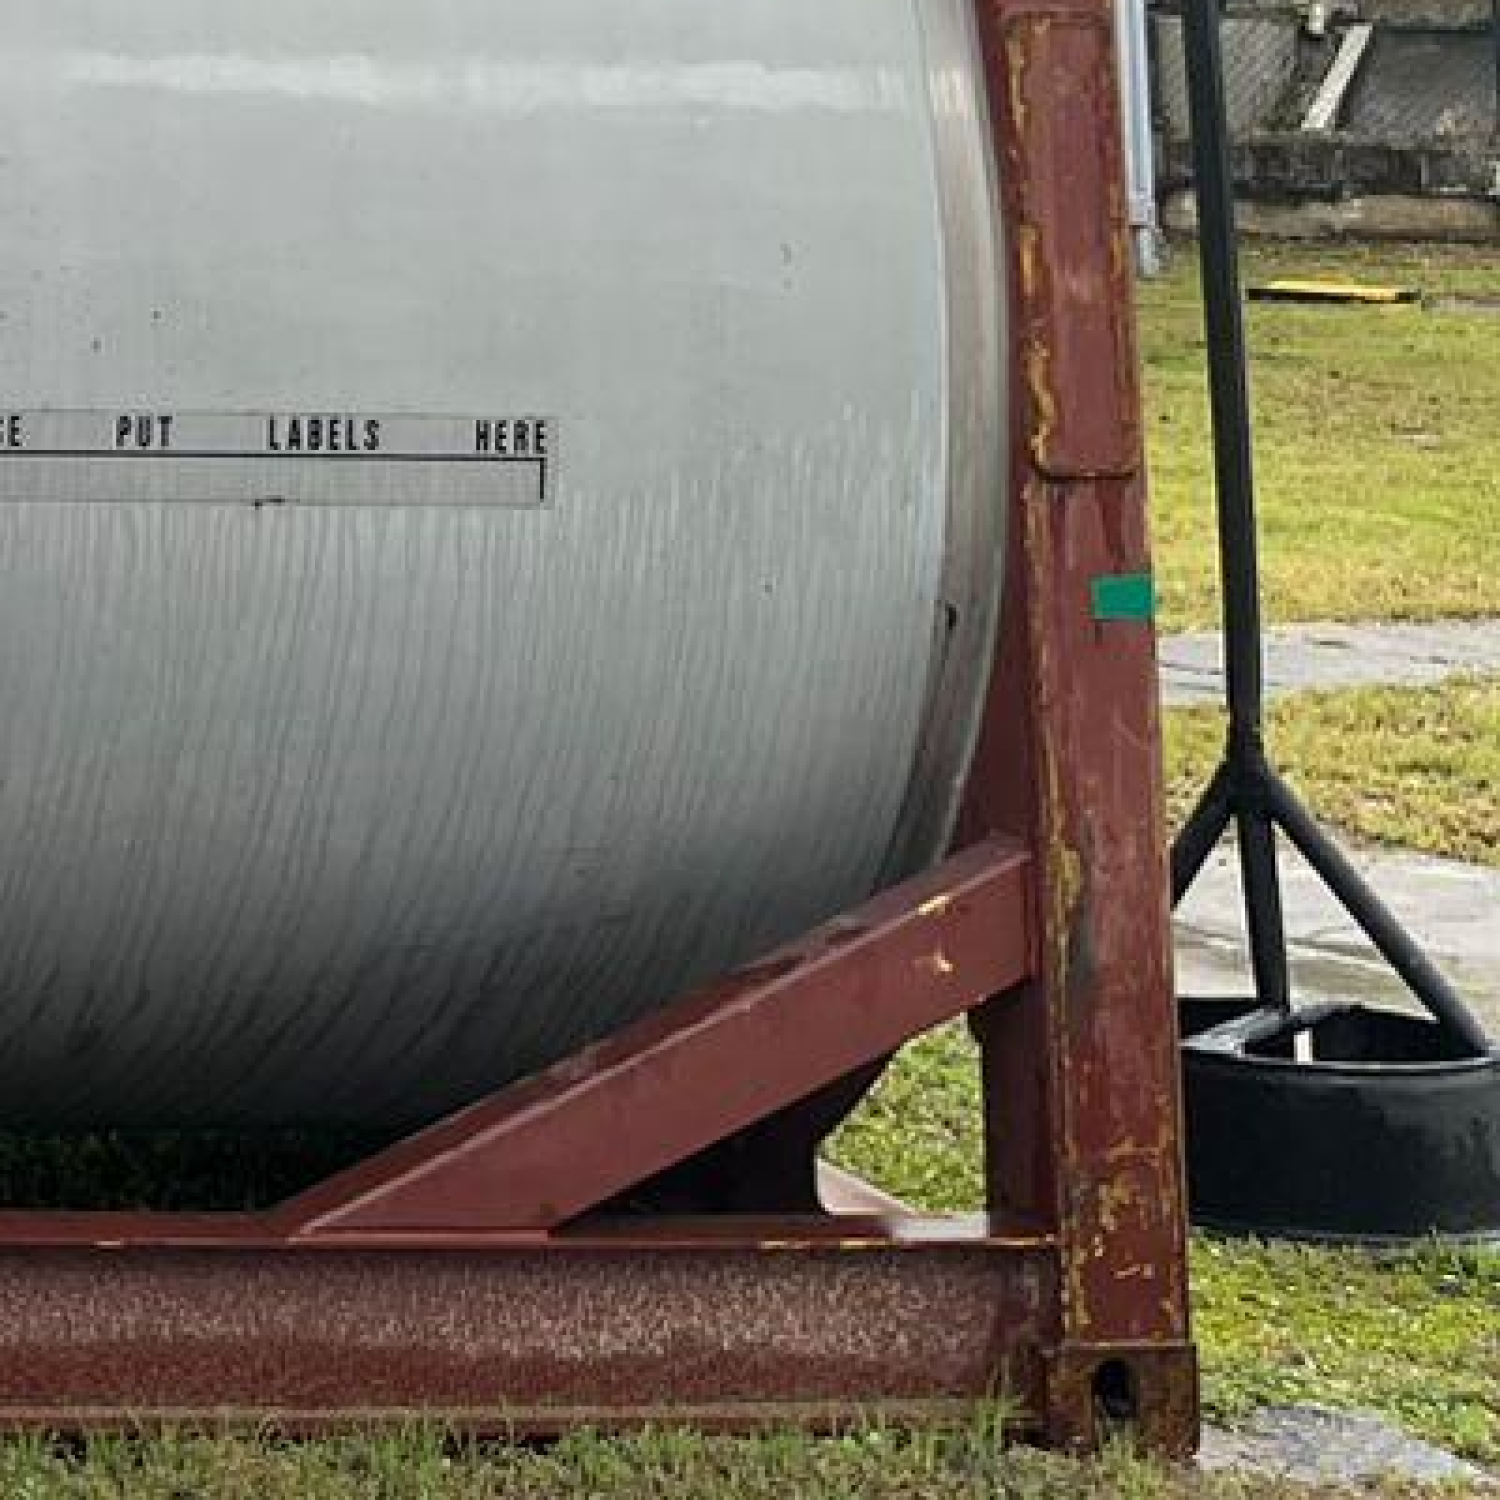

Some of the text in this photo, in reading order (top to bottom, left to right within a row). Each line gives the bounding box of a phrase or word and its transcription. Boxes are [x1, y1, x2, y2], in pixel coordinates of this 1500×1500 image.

[114, 414, 174, 448] PUT
[267, 416, 381, 451] LABELS
[473, 419, 548, 454] HERE
